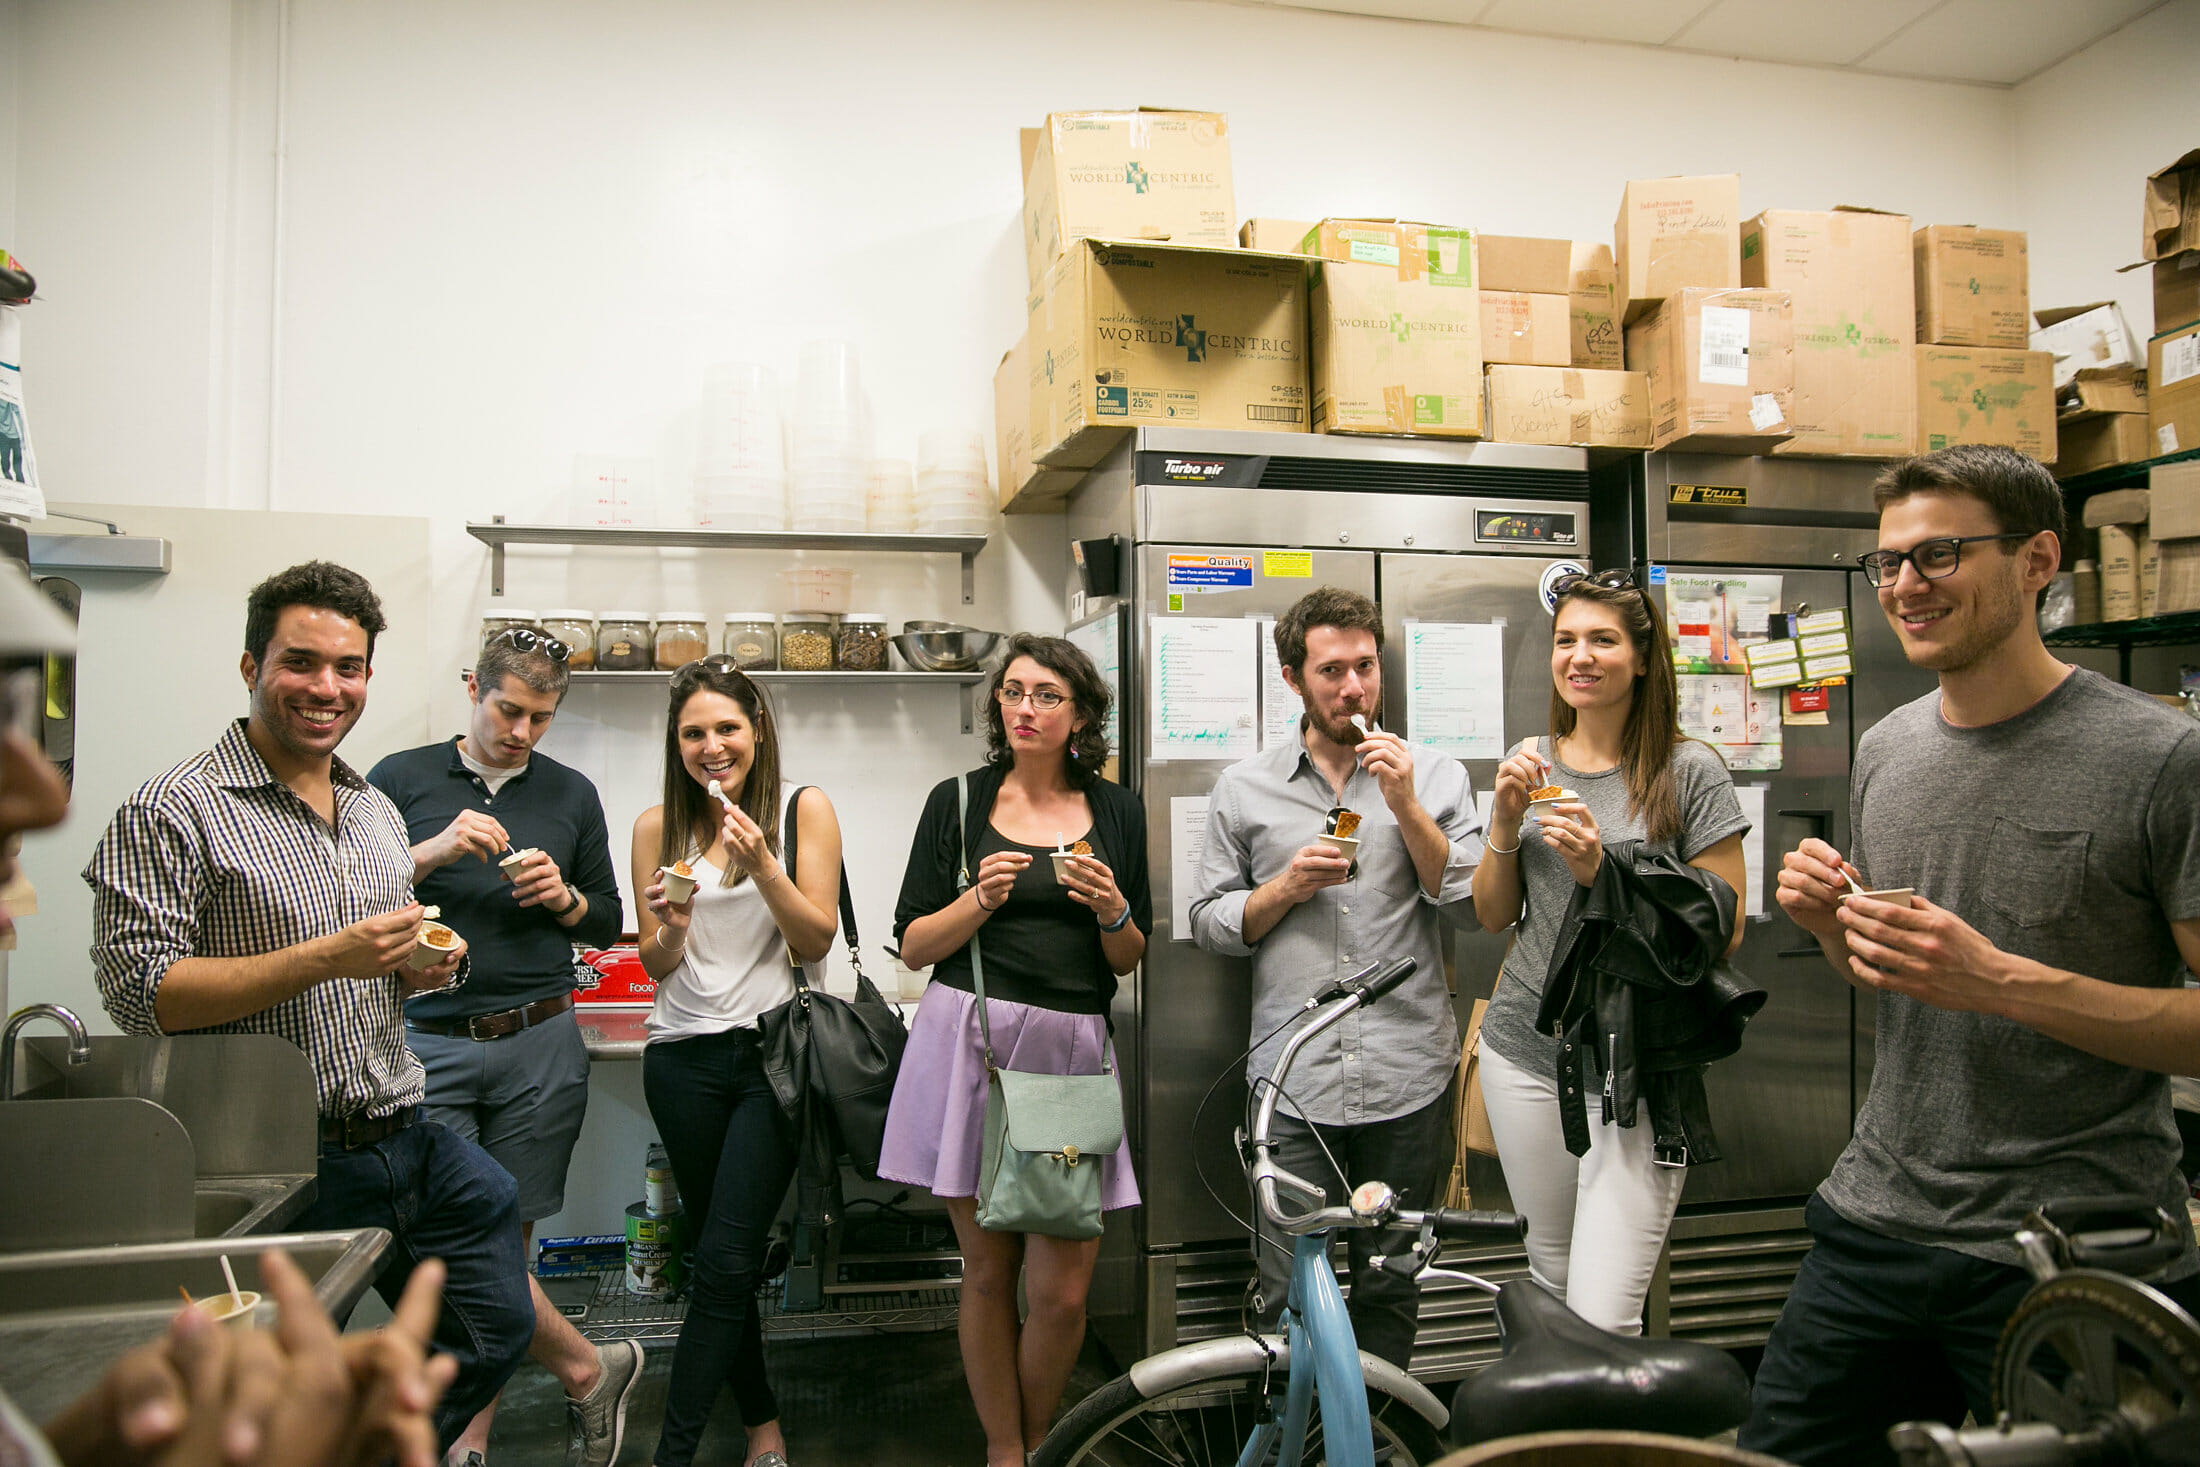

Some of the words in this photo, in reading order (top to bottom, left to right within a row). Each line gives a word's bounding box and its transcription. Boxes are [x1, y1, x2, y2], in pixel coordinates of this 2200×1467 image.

[1069, 173, 1124, 183] WORLD
[1149, 173, 1215, 183] CENTRIC
[1099, 312, 1174, 329] worldcentric.org
[1338, 319, 1388, 329] WORLD
[1411, 321, 1468, 333] CENTRIC
[1098, 327, 1173, 344] WORLD
[1207, 334, 1291, 353] CENTRIC
[1132, 399, 1153, 408] 25%
[1164, 459, 1202, 474] Turbo
[1203, 464, 1224, 475] air
[1696, 487, 1743, 499] true
[1208, 557, 1250, 569] Quality
[629, 982, 655, 993] FOOD
